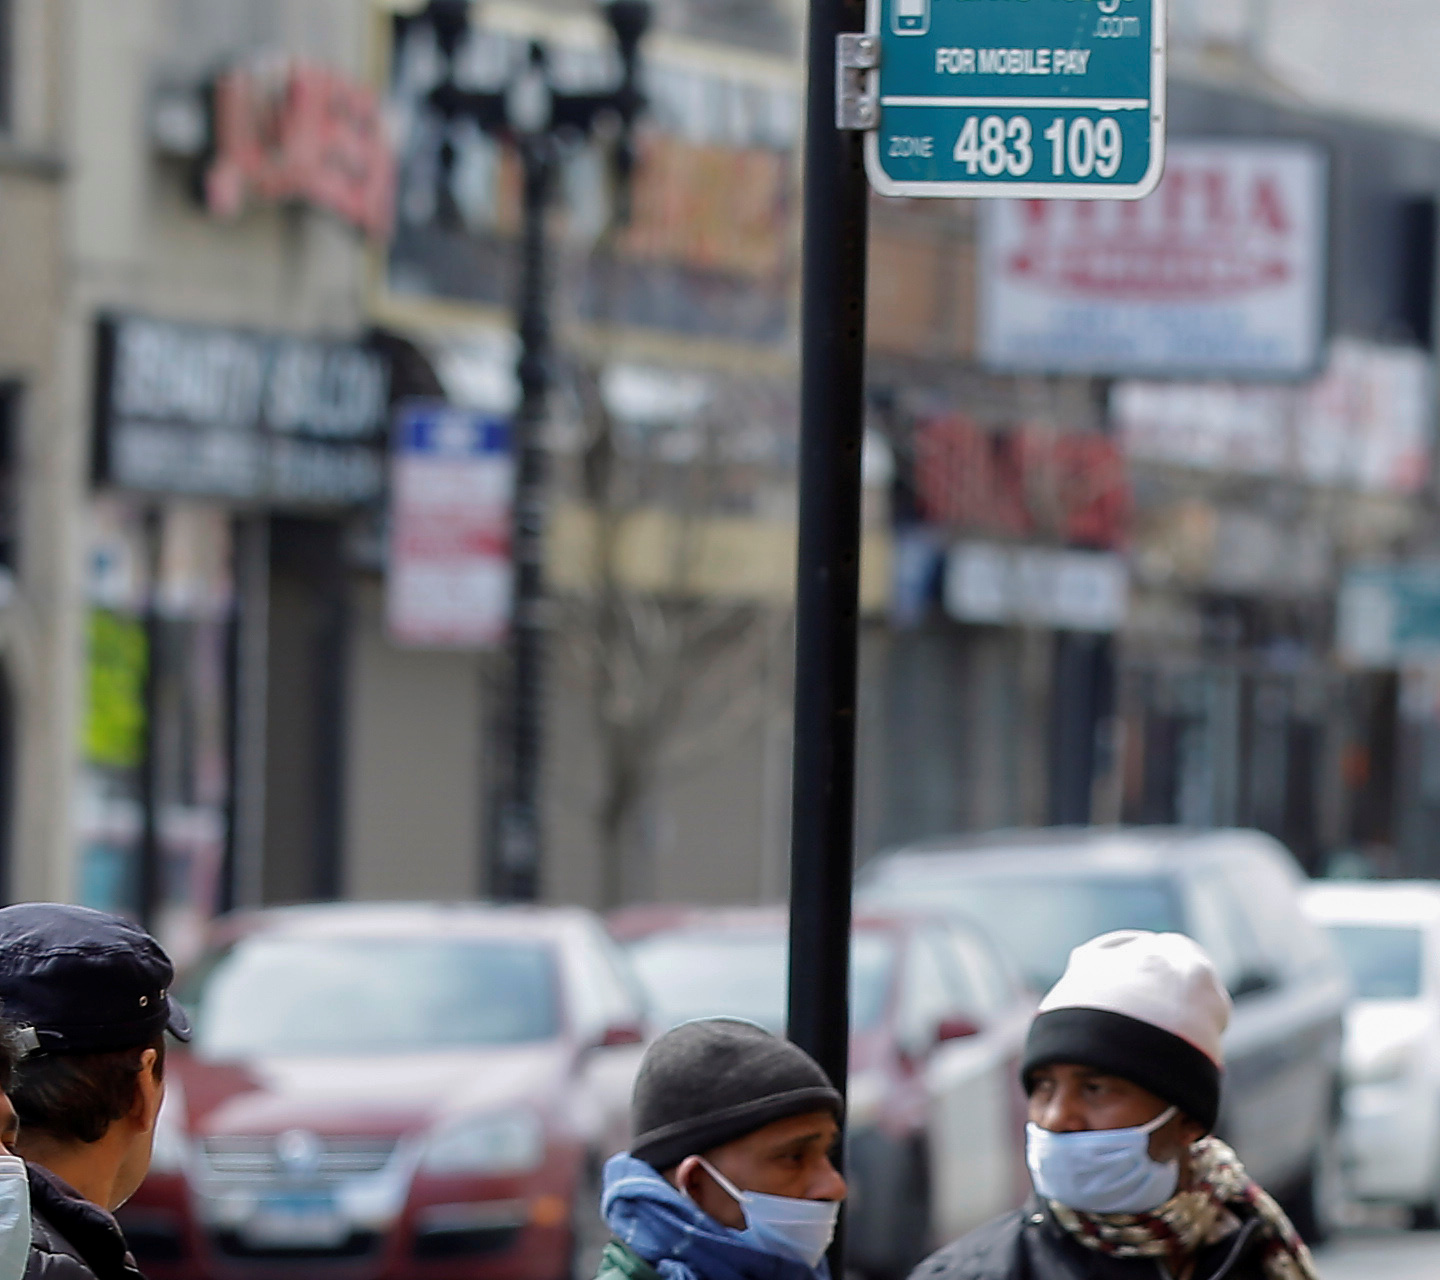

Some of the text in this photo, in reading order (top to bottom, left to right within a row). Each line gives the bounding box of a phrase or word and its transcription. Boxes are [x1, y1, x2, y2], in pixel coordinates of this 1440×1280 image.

[934, 48, 1092, 75] FOR MOBILE PAY
[888, 115, 1123, 178] ZONE 483 109
